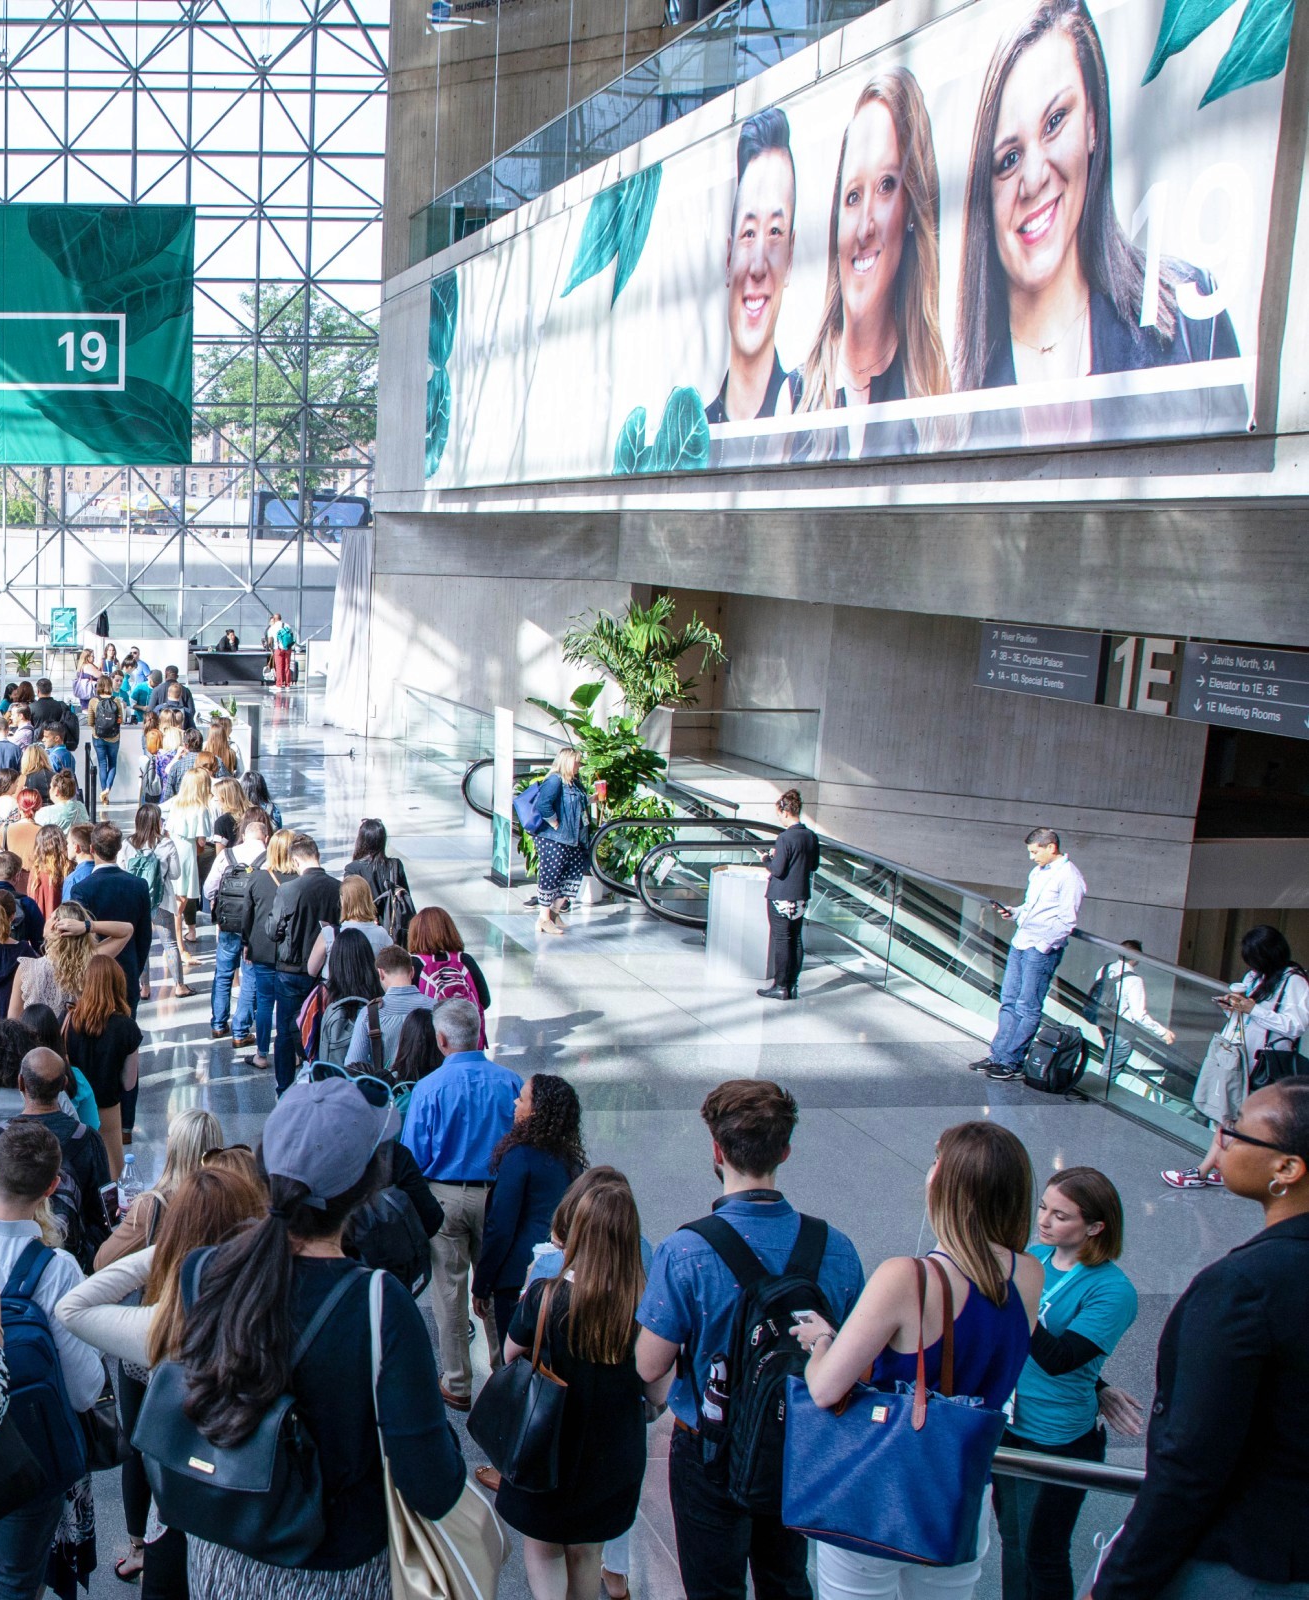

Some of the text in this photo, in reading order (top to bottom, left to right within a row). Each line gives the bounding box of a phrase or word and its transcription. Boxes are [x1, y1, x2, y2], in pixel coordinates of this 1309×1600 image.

[1130, 161, 1254, 327] 19
[57, 330, 107, 373] 19
[1001, 631, 1038, 644] River Pavilion
[1022, 654, 1042, 666] Crystal
[1043, 657, 1064, 668] Palace
[1211, 654, 1276, 671] Javits North, 3A
[1021, 674, 1042, 686] Special
[1043, 677, 1064, 689] Events
[1113, 636, 1177, 716] 1E
[1208, 677, 1279, 696] Elevator to 1E, 3E
[1206, 701, 1282, 721] 1E Meeting Rooms
